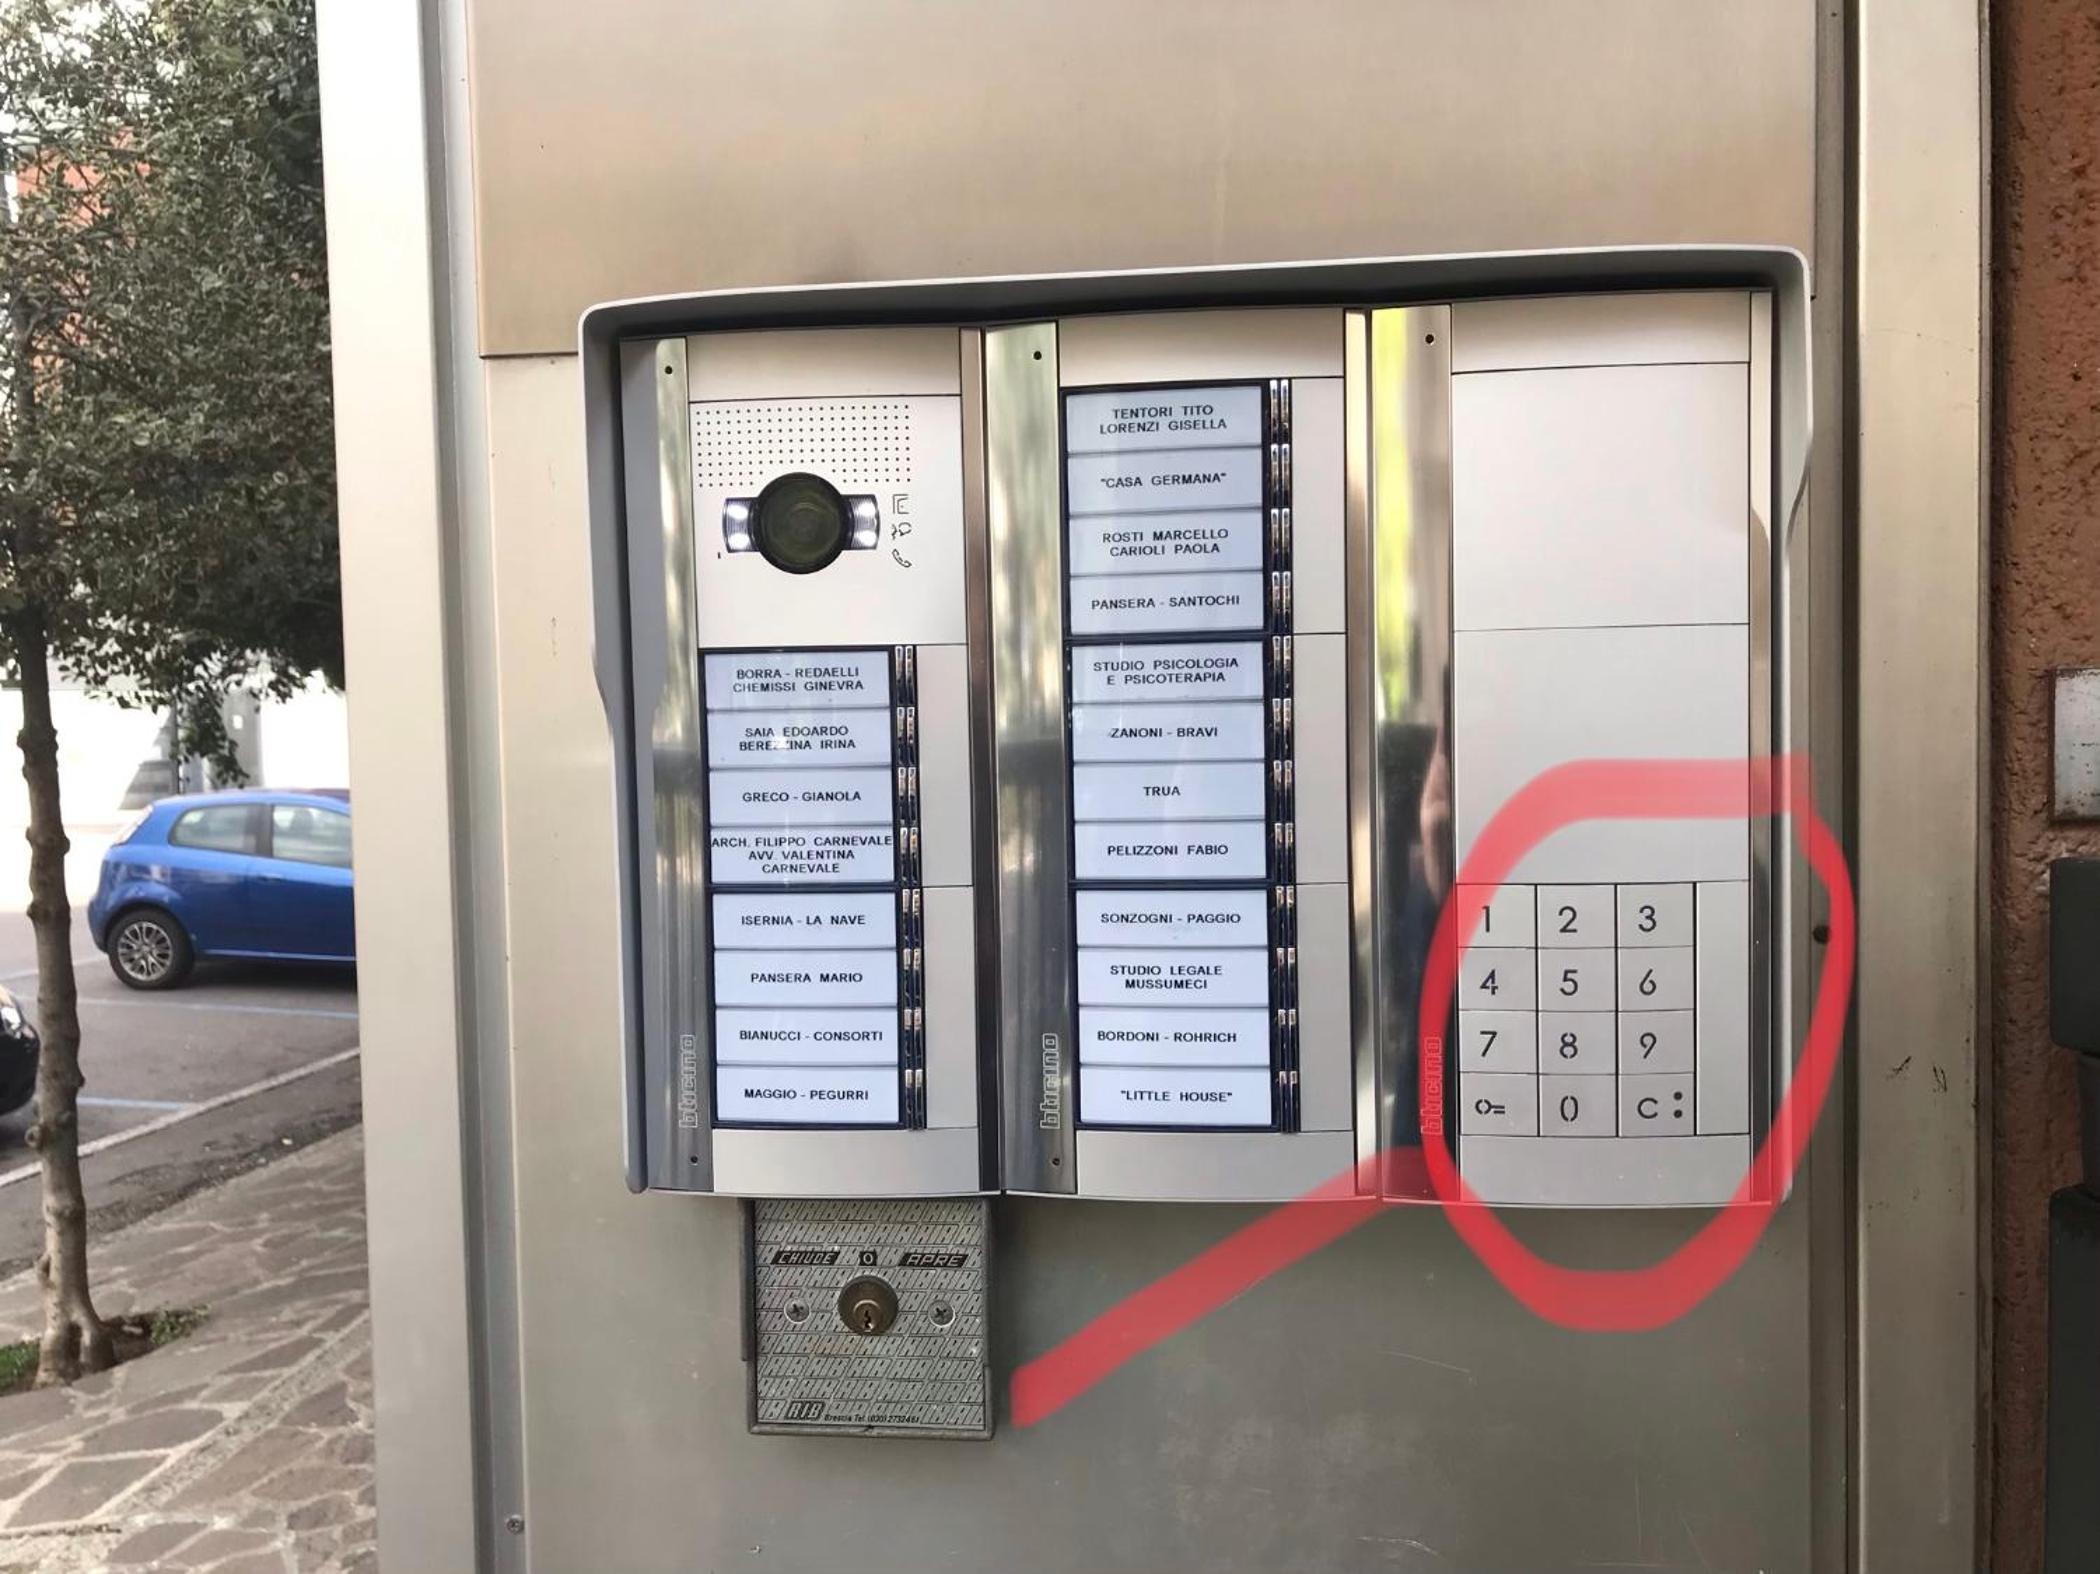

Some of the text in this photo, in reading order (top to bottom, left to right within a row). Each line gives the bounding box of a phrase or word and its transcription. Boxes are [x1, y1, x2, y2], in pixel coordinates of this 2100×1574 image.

[1112, 405, 1213, 420] TENTORI TITO
[1100, 419, 1227, 434] LORENZI GISELLA
[1102, 528, 1229, 543] ROSTI MARCELLO
[1110, 543, 1220, 557] CARIOLI PAOLA
[1091, 600, 1155, 611] PANSERA
[1169, 595, 1240, 607] SANTOCHI
[1093, 657, 1239, 672] STUDIO PSICOLOGIA
[736, 668, 781, 680] BORRA
[795, 667, 859, 678] REDAELLI
[1107, 672, 1226, 685] E PSICOTERAPIA
[733, 680, 864, 693] CHEMISSI GINEVRA
[745, 726, 848, 738] SAIA EDOARDO
[1110, 727, 1162, 738] ZANONI
[1177, 727, 1218, 738] BRAVI
[820, 739, 856, 750] IRINA
[742, 792, 789, 802] GRECO
[802, 791, 861, 802] GIANOLA
[1143, 786, 1181, 796] TRUA
[755, 837, 805, 847] FILIPPO
[814, 836, 891, 846] CARNEVALE
[782, 849, 855, 860] VALENTINA
[1107, 845, 1229, 856] PELIZZONI FABIO
[762, 863, 840, 874] CARNEVALE
[741, 916, 793, 926] ISERNIA
[806, 915, 822, 925] LA
[830, 915, 866, 925] NAVE
[1100, 913, 1173, 924] SONZOGNI
[1187, 913, 1241, 924] PAGGIO
[1482, 905, 1491, 933] 1
[1558, 906, 1578, 933] 2
[1638, 905, 1657, 932] 3
[1110, 965, 1223, 976] STUDIO LEGALE
[751, 973, 863, 983] PANSERA MARIO
[1125, 979, 1207, 989] MUSSUMECI
[1479, 969, 1498, 995] 4
[1559, 969, 1578, 996] 5
[1639, 969, 1657, 995] 6
[739, 1030, 801, 1041] BIANUCCI
[813, 1031, 883, 1042] CONSORTI
[1097, 1031, 1159, 1042] BORDONI
[1174, 1032, 1237, 1043] ROHRICH
[1479, 1031, 1498, 1057] 7
[1559, 1032, 1578, 1059] 8
[1639, 1032, 1657, 1059] 9
[679, 1034, 698, 1128] bticino
[1040, 1033, 1060, 1129] bticino
[744, 1088, 797, 1099] MAGGIO
[810, 1090, 869, 1100] PEGURRI
[1120, 1090, 1233, 1102] "LITTLE HOUSE"
[1560, 1096, 1579, 1121] 0
[778, 1253, 835, 1264] CHIUDE
[906, 1254, 962, 1266] APRE
